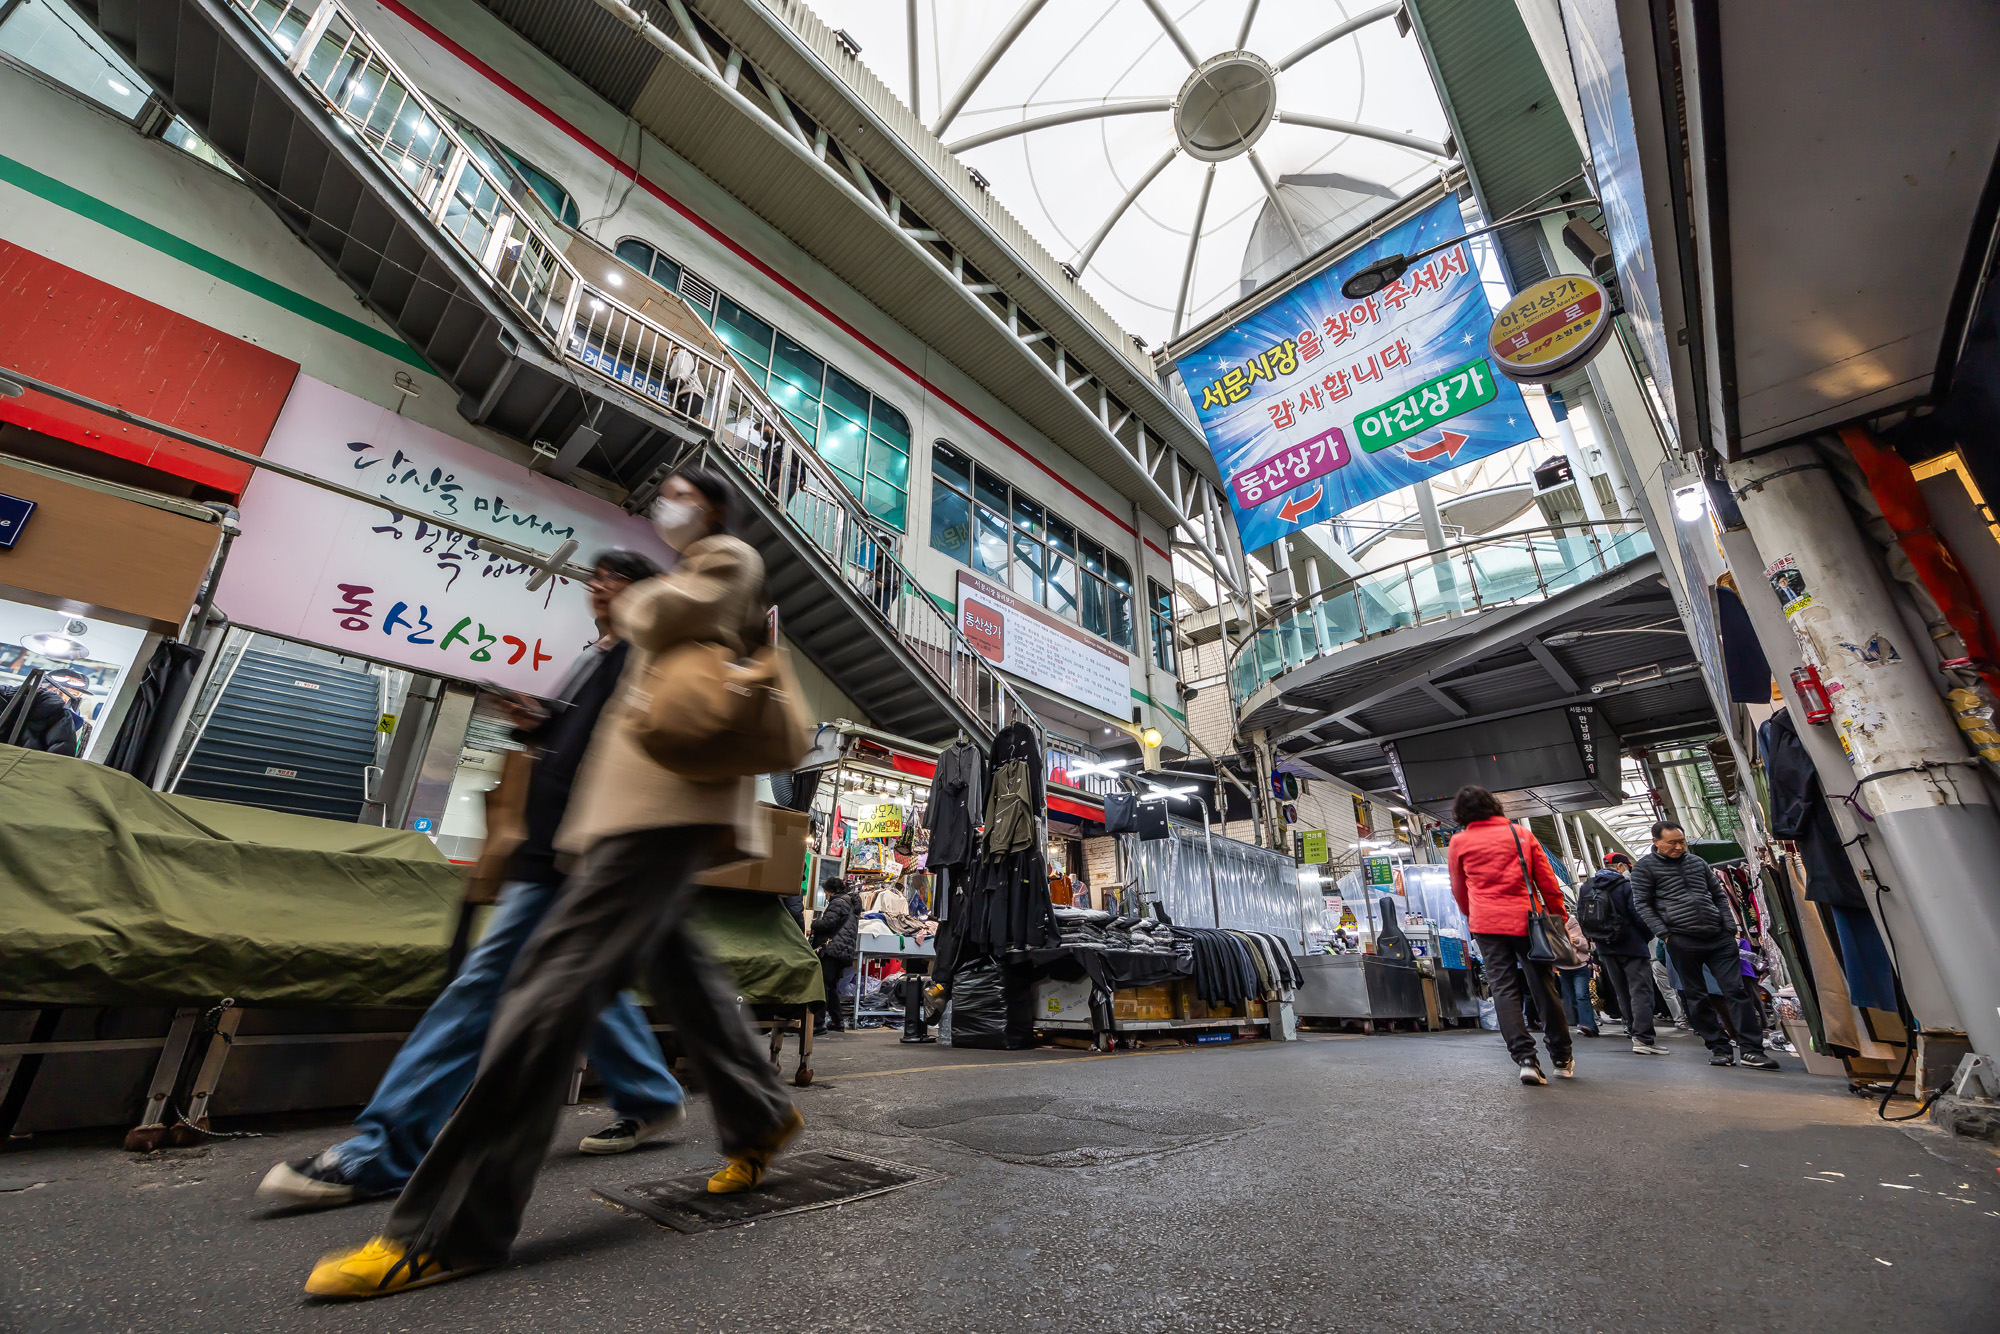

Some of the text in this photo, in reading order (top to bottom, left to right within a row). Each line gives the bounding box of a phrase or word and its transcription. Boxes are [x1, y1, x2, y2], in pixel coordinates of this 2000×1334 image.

[1500, 279, 1577, 328] 아진상가
[1502, 291, 1584, 337] Daegu Seomun Market
[1202, 246, 1470, 410] 서문시장을 찾아 주셔서
[1555, 318, 1593, 342] 소방통로
[1267, 337, 1411, 431] 감사합니다
[1361, 367, 1485, 438] 아진상가
[1239, 435, 1340, 501] 동산상가
[474, 496, 575, 540] 만나서
[331, 583, 553, 672] 동산상가
[964, 611, 1002, 640] 동산상가
[1578, 715, 1591, 741] 만남의
[1583, 744, 1595, 761] 장소
